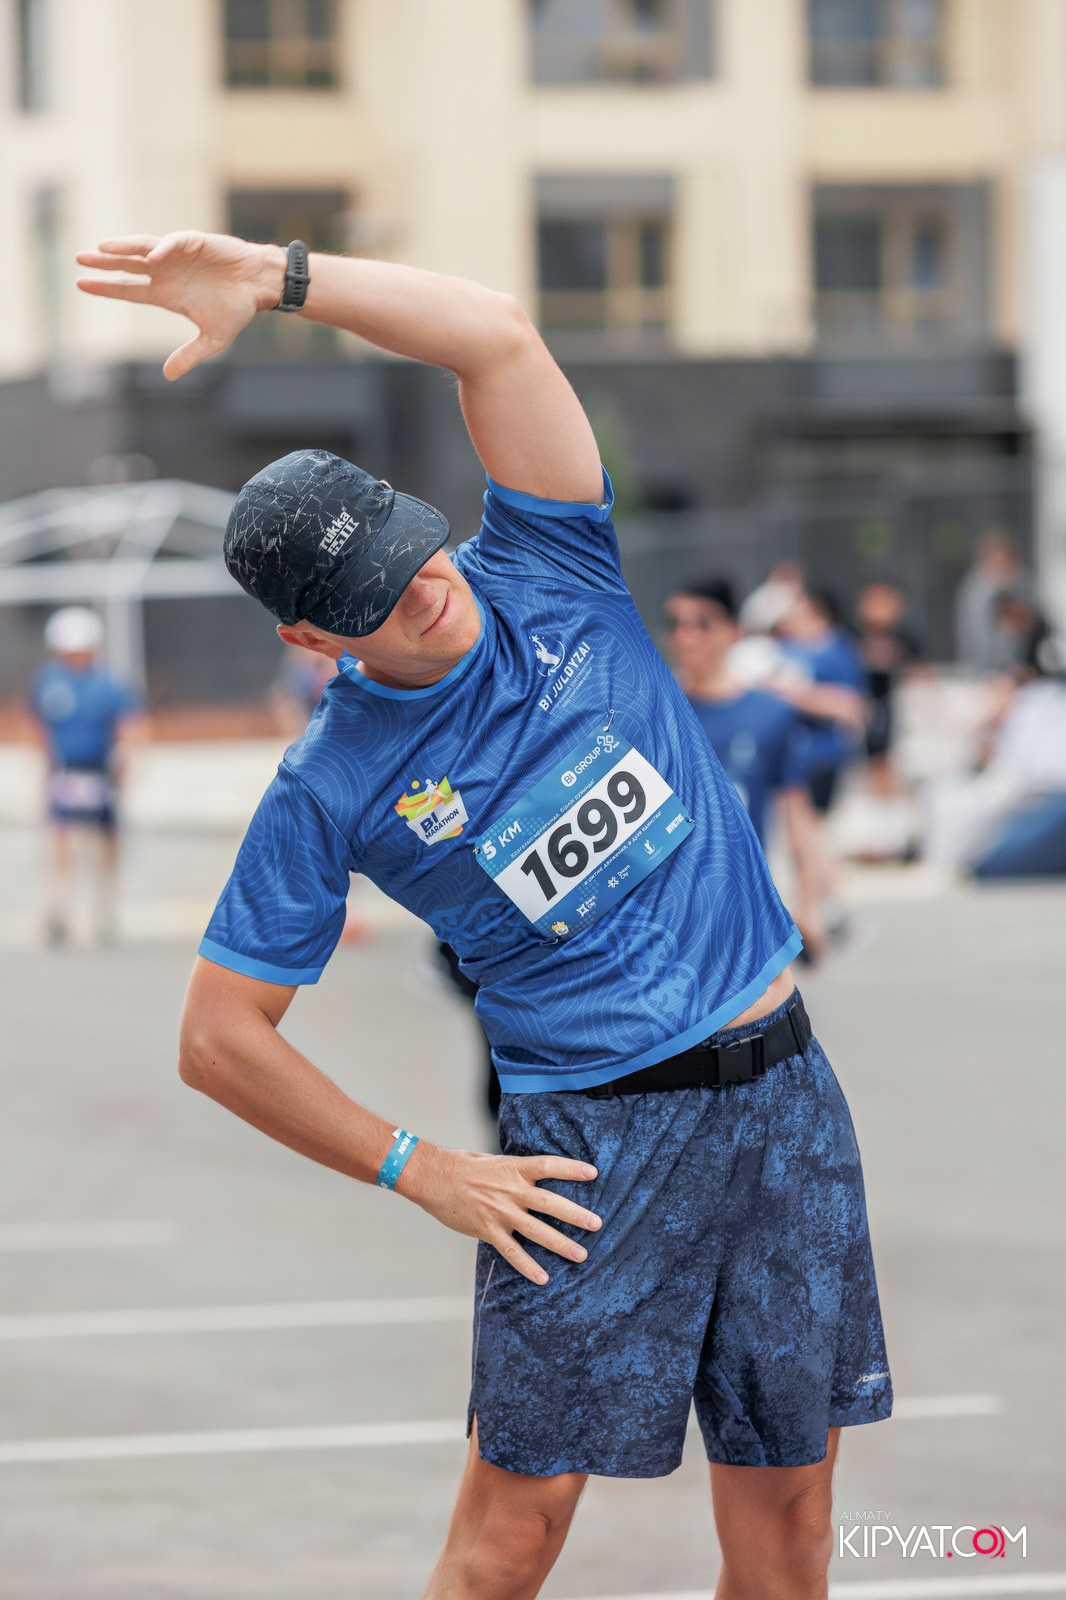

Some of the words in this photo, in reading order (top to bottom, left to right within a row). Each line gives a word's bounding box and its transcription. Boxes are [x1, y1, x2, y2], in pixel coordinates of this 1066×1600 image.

[320, 511, 351, 550] rukka
[538, 694, 552, 711] BI
[552, 641, 590, 698] JULDYZAI
[563, 772, 575, 785] BI
[574, 747, 601, 775] GROUP
[420, 811, 439, 833] BI
[425, 808, 460, 840] MARATHON
[481, 840, 497, 860] 5
[498, 820, 522, 848] KM
[520, 771, 647, 902] 1699
[617, 864, 630, 878] Dream
